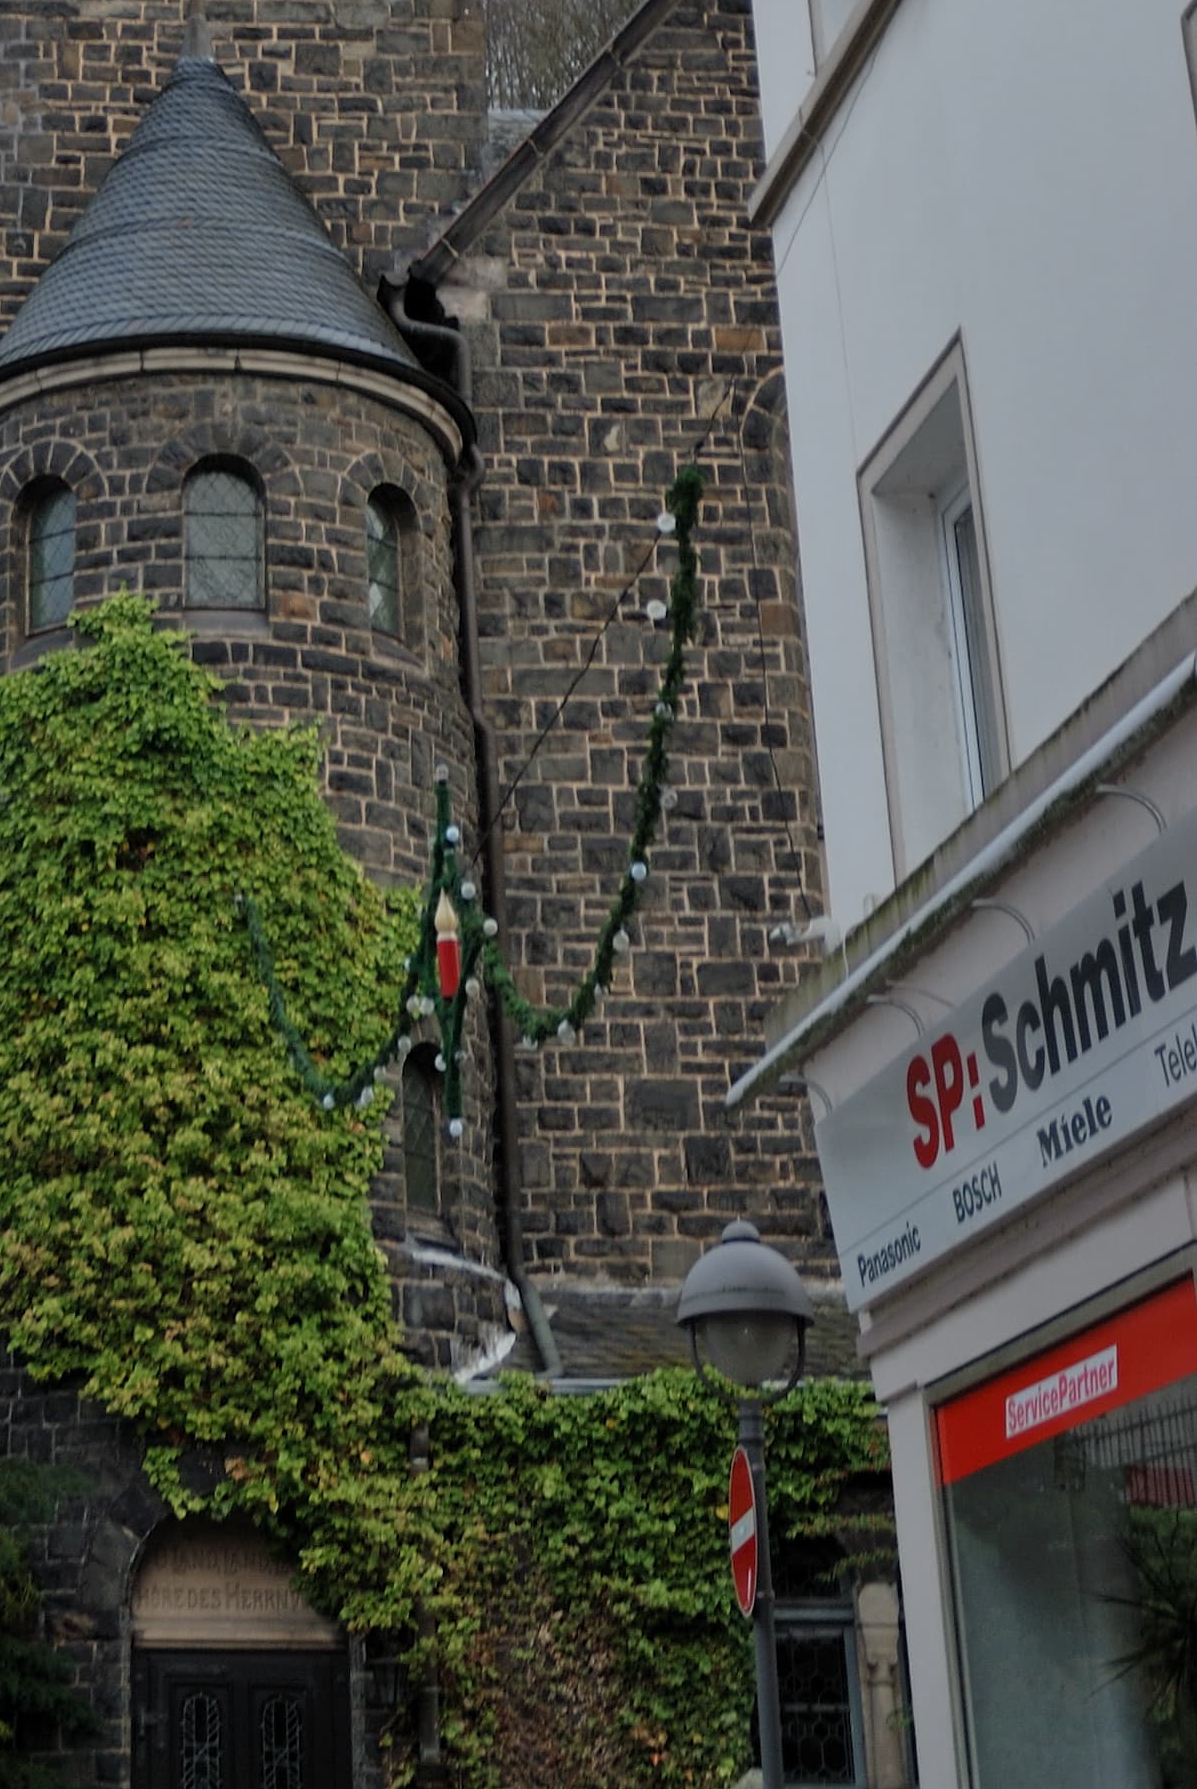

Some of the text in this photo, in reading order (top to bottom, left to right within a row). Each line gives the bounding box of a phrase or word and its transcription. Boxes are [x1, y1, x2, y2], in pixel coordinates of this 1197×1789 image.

[981, 877, 1197, 1114] Schmitz
[857, 1221, 921, 1288] Panasonic
[952, 1161, 1002, 1224] BOSCH
[1036, 1095, 1114, 1168] Miele
[1007, 1358, 1116, 1432] ServicePartner
